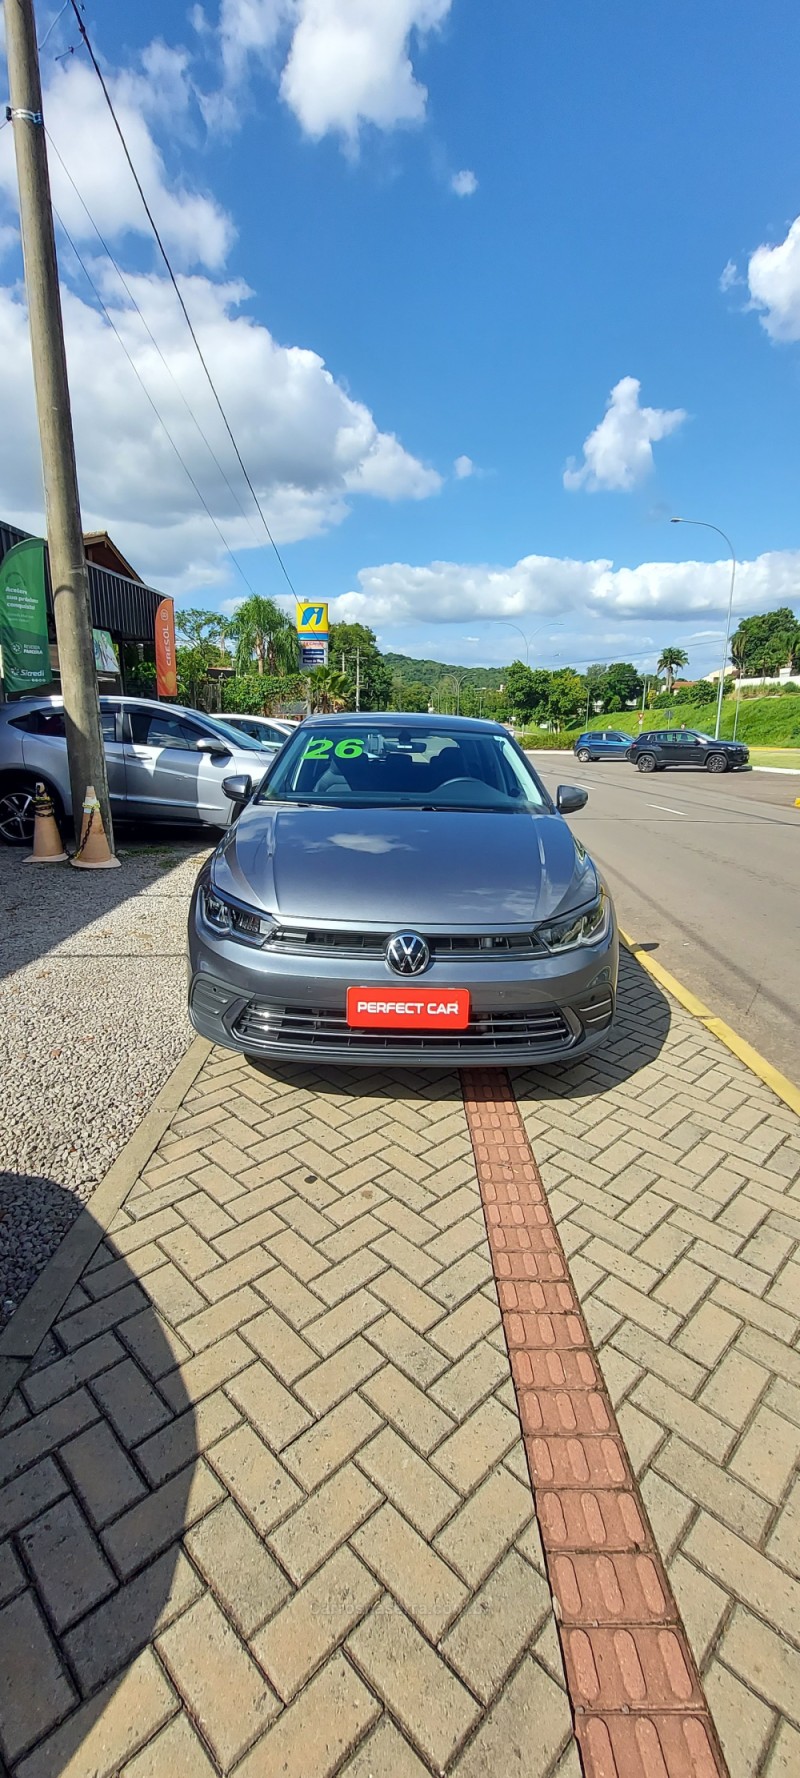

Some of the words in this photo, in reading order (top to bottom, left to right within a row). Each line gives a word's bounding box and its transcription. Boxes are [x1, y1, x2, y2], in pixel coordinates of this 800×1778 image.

[163, 625, 171, 666] CRESOL
[20, 669, 45, 677] Sicredi
[302, 739, 364, 759] 26
[357, 1001, 424, 1014] PERFECT
[427, 1002, 459, 1015] CAR
